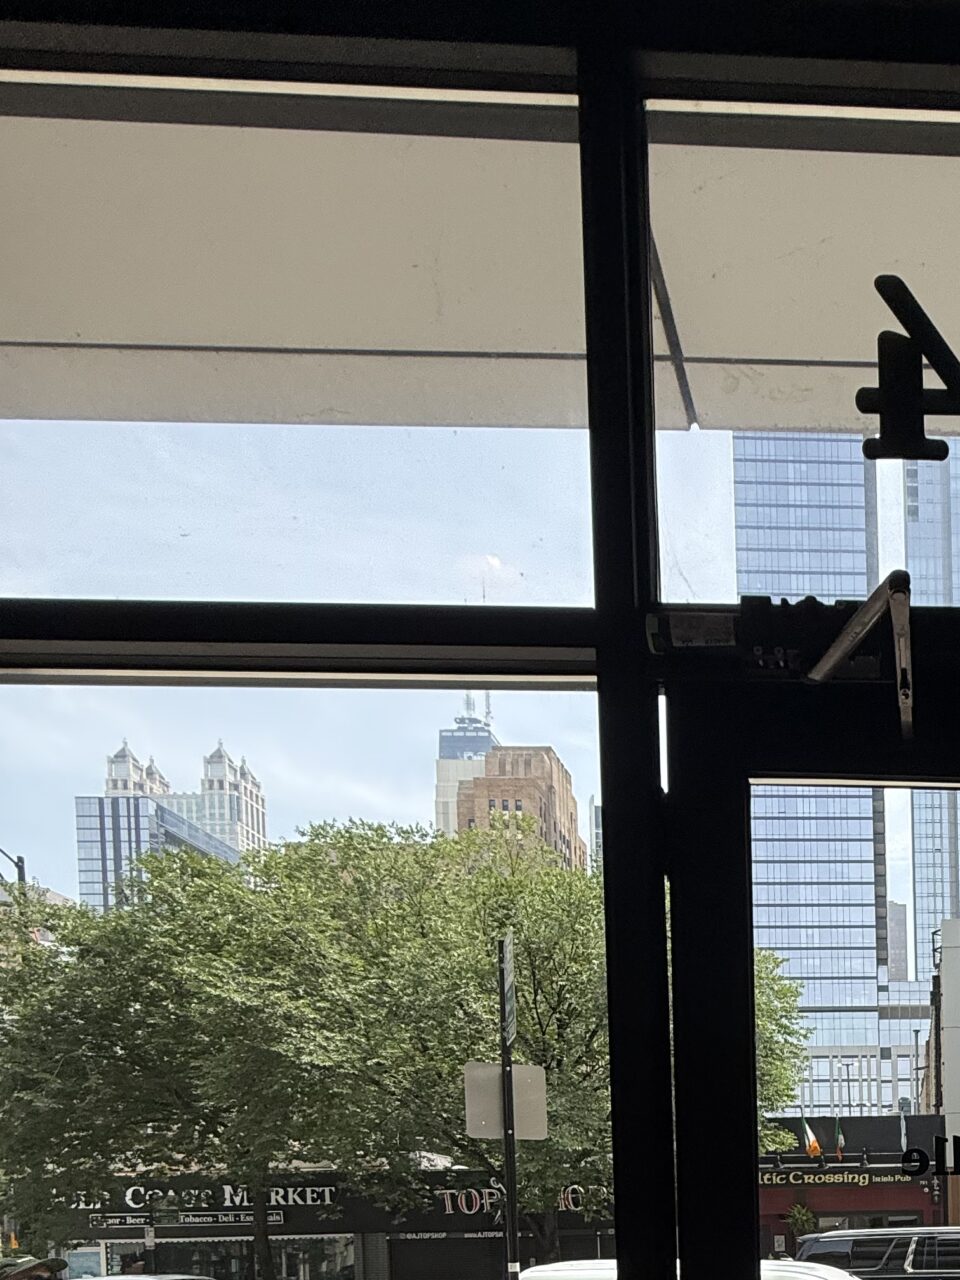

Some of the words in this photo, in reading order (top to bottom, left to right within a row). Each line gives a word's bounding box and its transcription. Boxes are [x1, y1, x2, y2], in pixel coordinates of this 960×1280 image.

[758, 1172, 786, 1184] ltic
[789, 1171, 869, 1186] Crossing
[895, 1174, 912, 1182] Pub
[222, 1184, 335, 1206] MRKET
[435, 1188, 501, 1215] TOP
[126, 1216, 146, 1224] Beer
[180, 1214, 213, 1223] Tobacco
[218, 1213, 235, 1222] Deli
